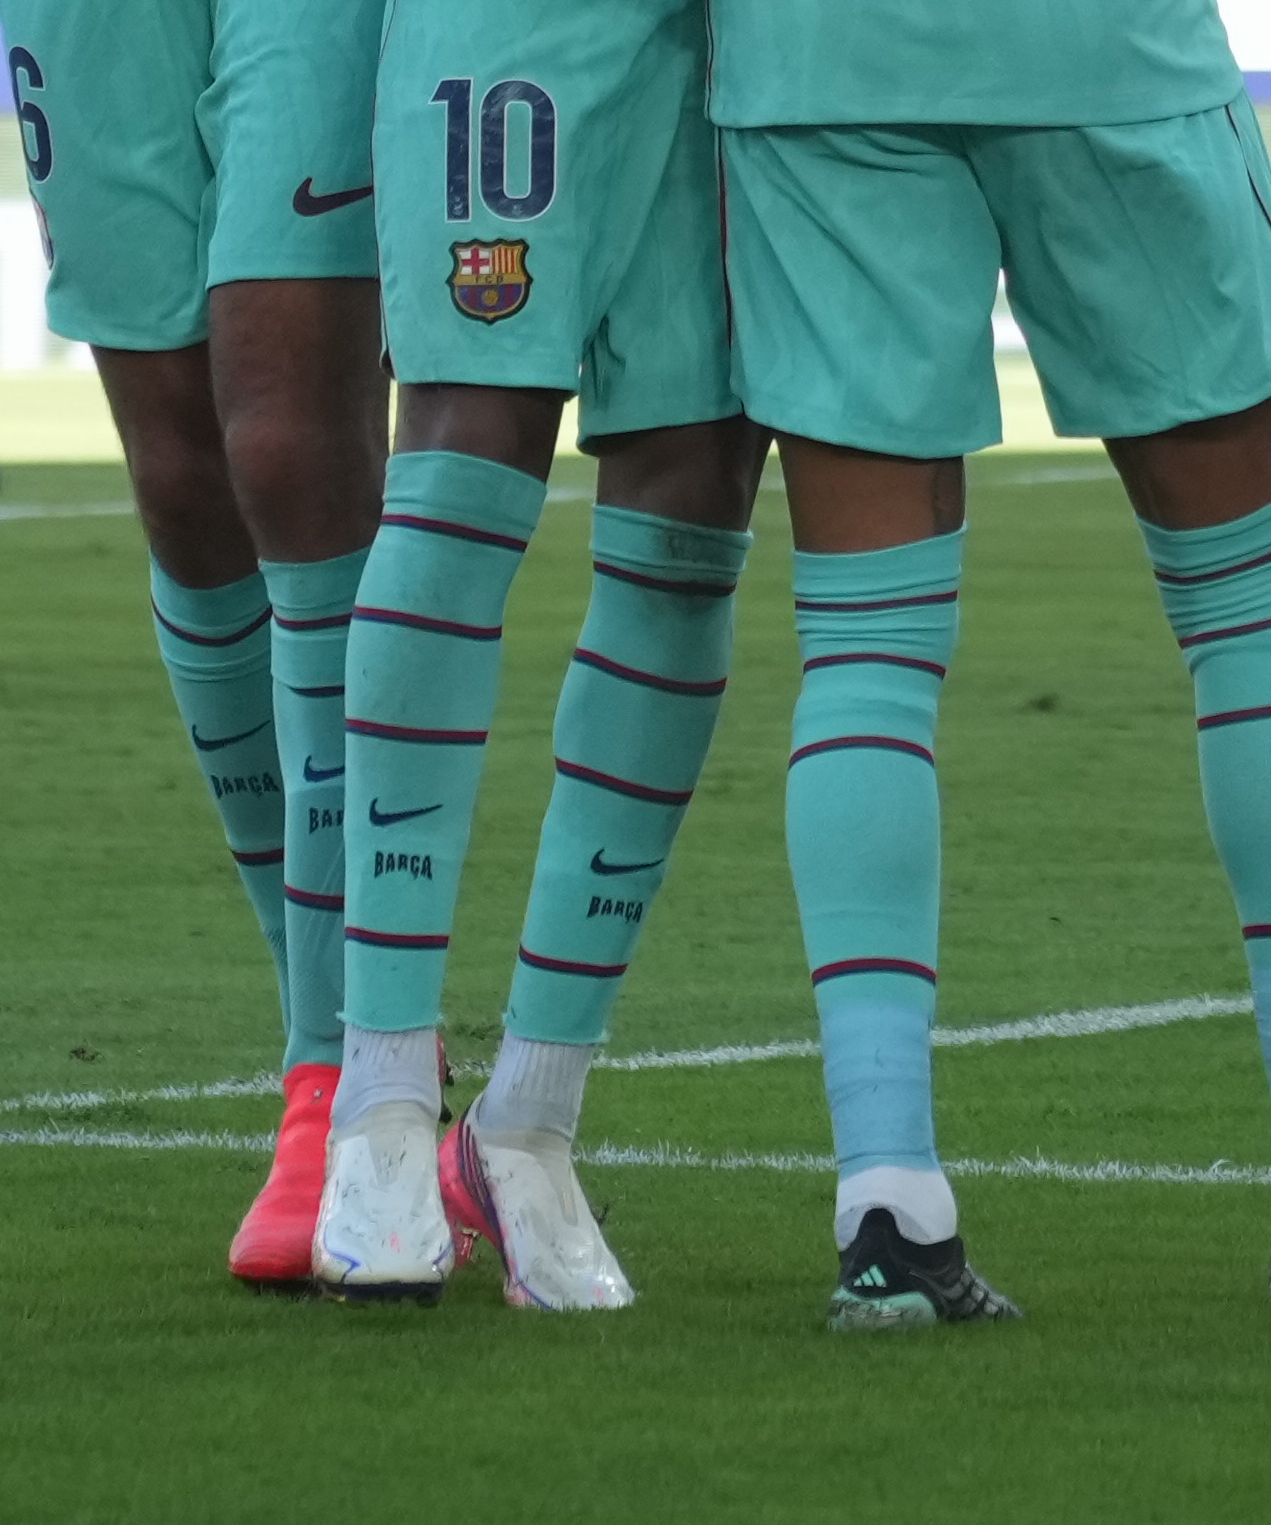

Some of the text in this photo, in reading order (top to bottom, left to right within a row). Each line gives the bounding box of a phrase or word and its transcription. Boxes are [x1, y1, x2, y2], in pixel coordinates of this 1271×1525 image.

[429, 77, 557, 223] 10
[374, 850, 433, 881] BARÇA
[586, 895, 644, 924] BARÇA
